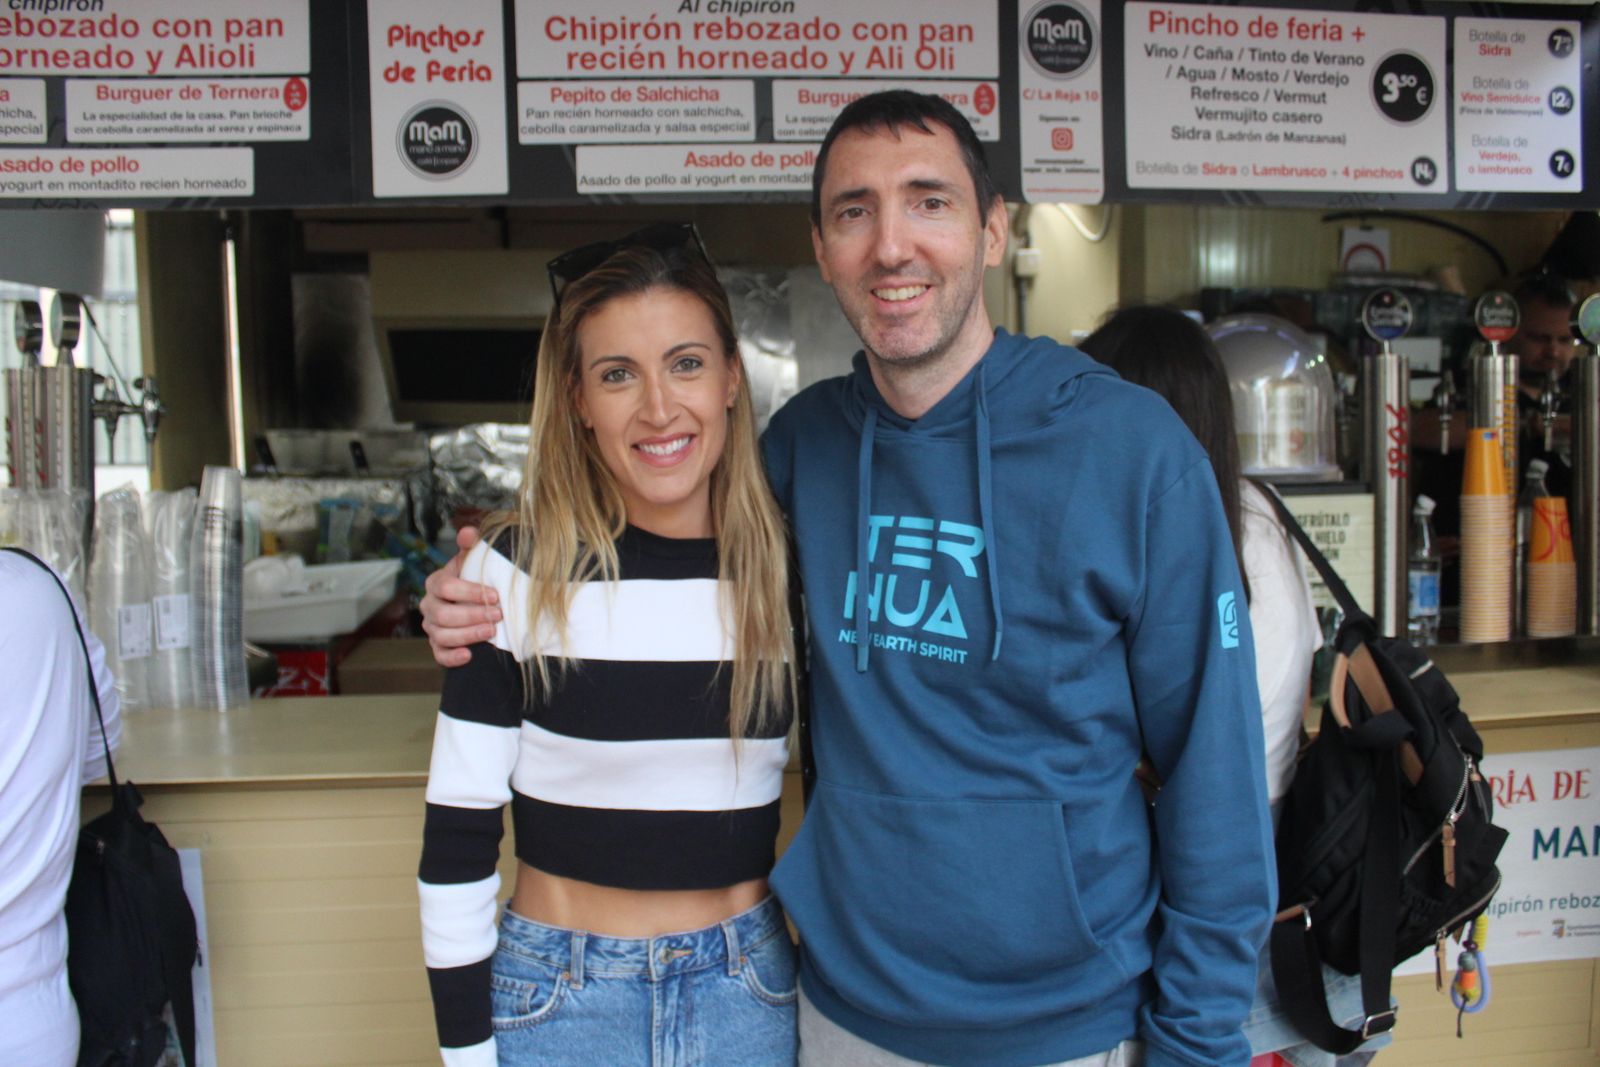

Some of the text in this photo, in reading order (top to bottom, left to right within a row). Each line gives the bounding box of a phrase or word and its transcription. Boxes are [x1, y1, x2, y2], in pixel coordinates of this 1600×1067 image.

[152, 20, 212, 38] con
[225, 18, 284, 42] pan
[545, 14, 974, 47] Chipirón rebozado con pan
[1149, 10, 1239, 36] Pincho
[1247, 16, 1278, 38] de
[1287, 17, 1343, 42] feria
[388, 24, 485, 53] Pinchos
[1511, 30, 1526, 43] de
[147, 48, 164, 74] y
[175, 43, 255, 69] Alioli
[567, 44, 955, 74] recién horneado y Ali Oli
[1144, 43, 1178, 58] Vino
[1194, 45, 1233, 61] Caña
[1249, 48, 1287, 63] Tinto
[1290, 50, 1309, 64] de
[1314, 51, 1365, 66] Verano
[1478, 44, 1512, 57] Sidra
[383, 60, 415, 83] de
[1177, 66, 1216, 82] Agua
[1232, 68, 1279, 83] Mosto
[1293, 71, 1349, 87] Verdejo
[96, 84, 173, 104] Burguer
[179, 85, 202, 100] de
[208, 84, 280, 100] Ternera
[1514, 78, 1529, 90] de
[550, 85, 720, 105] Pepito de Salchicha
[798, 88, 866, 108] Burgue
[1191, 86, 1259, 103] Refresco
[1273, 90, 1327, 105] Vermut
[170, 110, 184, 120] de
[526, 108, 549, 119] Pan
[594, 107, 652, 118] horneado
[657, 109, 679, 118] con
[1195, 106, 1323, 124] Vermujito casero
[520, 122, 750, 135] cebolla caramelizada y salsa especial
[1171, 125, 1211, 141] Sidra
[1265, 131, 1280, 142] de
[1284, 132, 1347, 145] Manzanas)
[1513, 136, 1528, 148] de
[60, 157, 84, 172] de
[91, 156, 139, 175] pollo
[684, 150, 818, 170] Asado de poll
[579, 175, 620, 186] Asado
[624, 174, 640, 186] de
[645, 174, 677, 188] pollo
[680, 174, 691, 185] al
[695, 174, 736, 187] yogurt
[740, 176, 755, 184] en
[1182, 163, 1198, 175] de
[1201, 162, 1237, 176] Sidra
[1252, 163, 1327, 178] Lambrusco
[1353, 166, 1404, 181] pinchos
[0, 179, 43, 192] yogurt
[49, 182, 64, 190] en
[68, 179, 135, 190] montadito
[184, 178, 247, 189] horneado
[868, 515, 985, 578] TER
[838, 629, 968, 664] NE EARTH SPIRIT
[1552, 768, 1592, 801] DE
